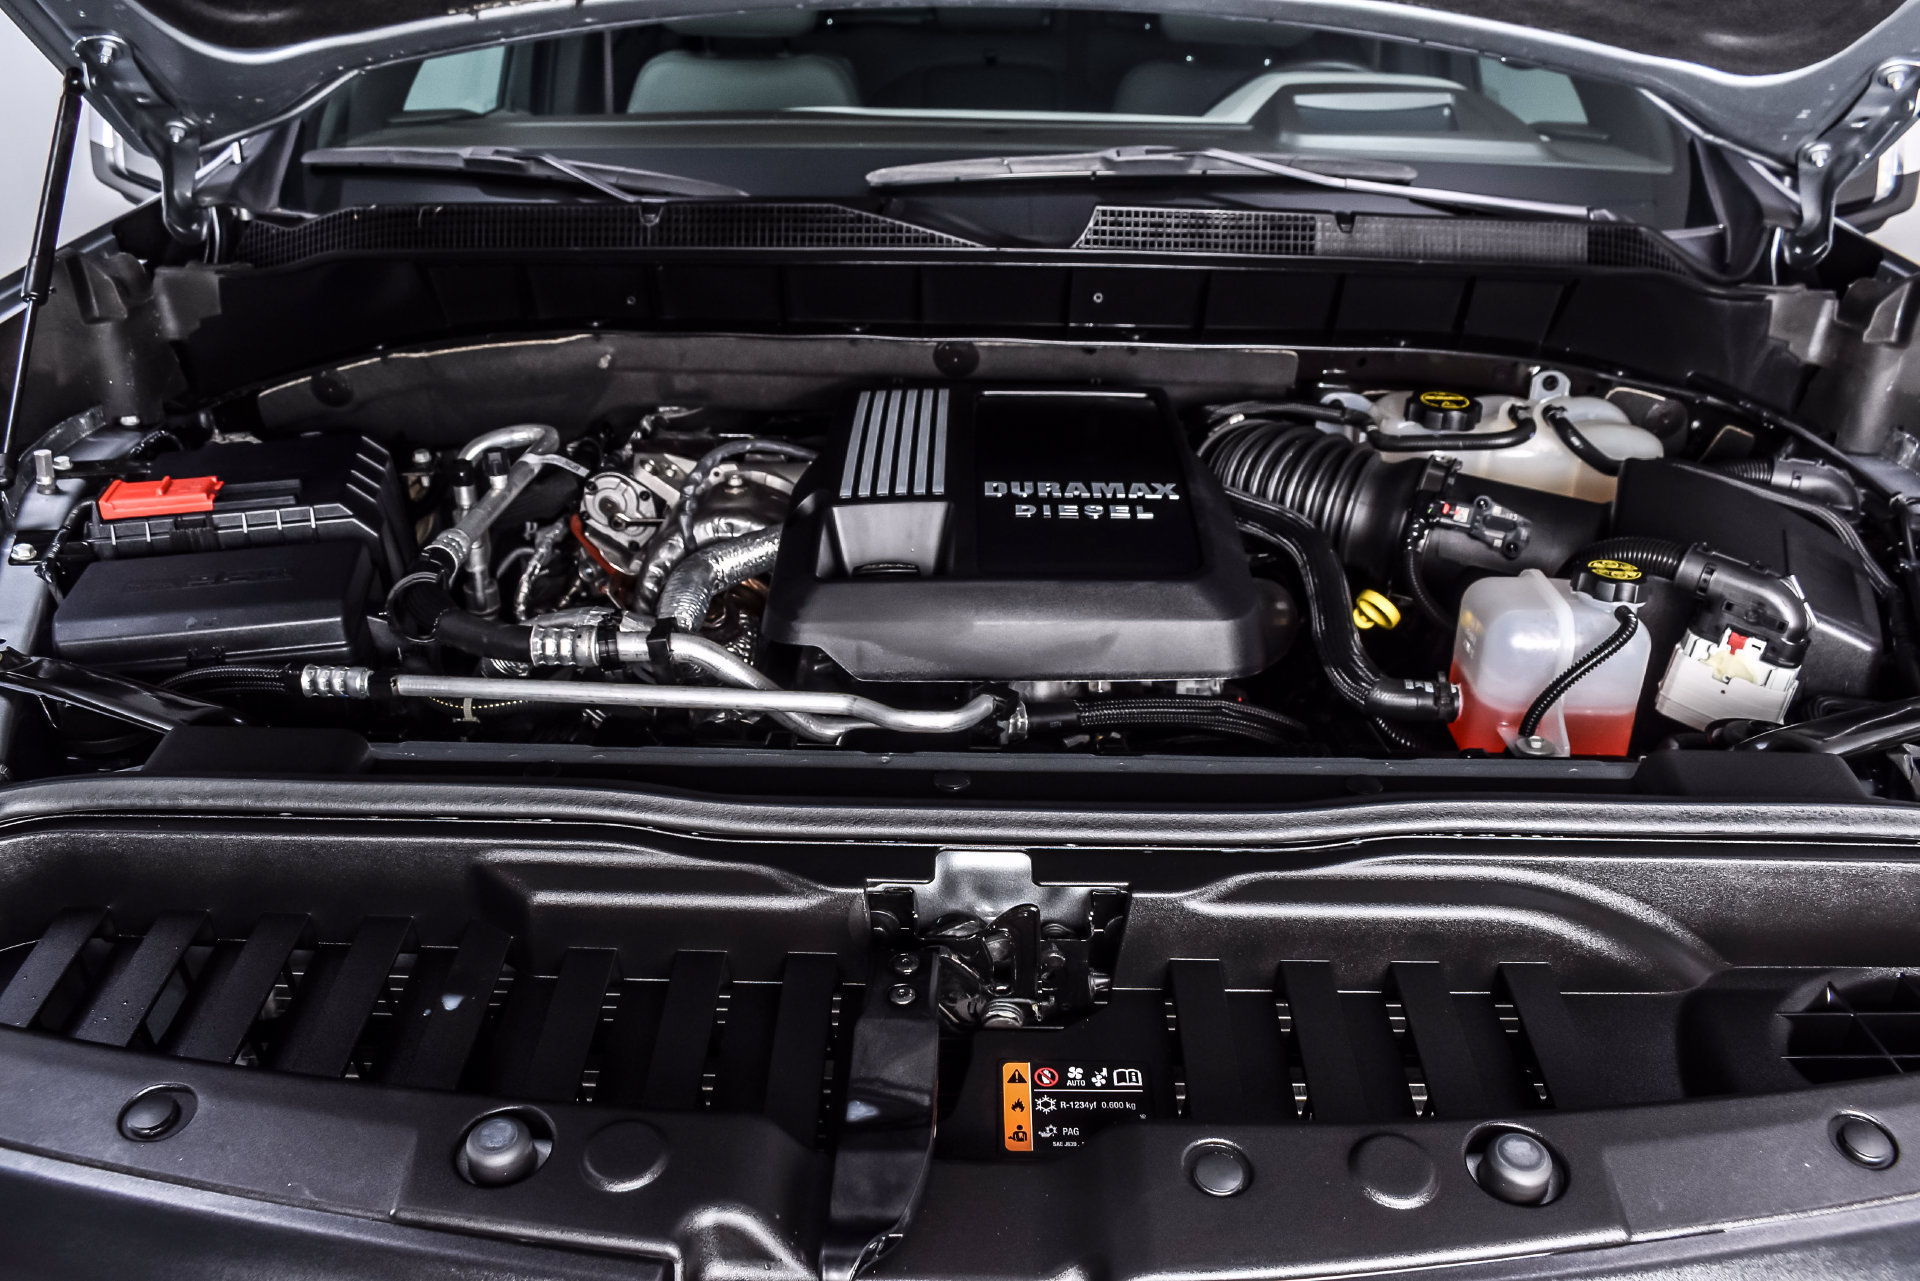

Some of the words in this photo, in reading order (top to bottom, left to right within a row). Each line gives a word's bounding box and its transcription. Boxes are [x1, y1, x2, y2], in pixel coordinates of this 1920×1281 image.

[984, 481, 1180, 500] DURAMAX
[1015, 504, 1155, 520] DIESEL
[1066, 1079, 1086, 1087] AUTO
[1060, 1101, 1097, 1110] R-1234yf
[1101, 1101, 1124, 1109] 0.600
[1125, 1101, 1137, 1110] kg
[1062, 1127, 1080, 1136] PAG
